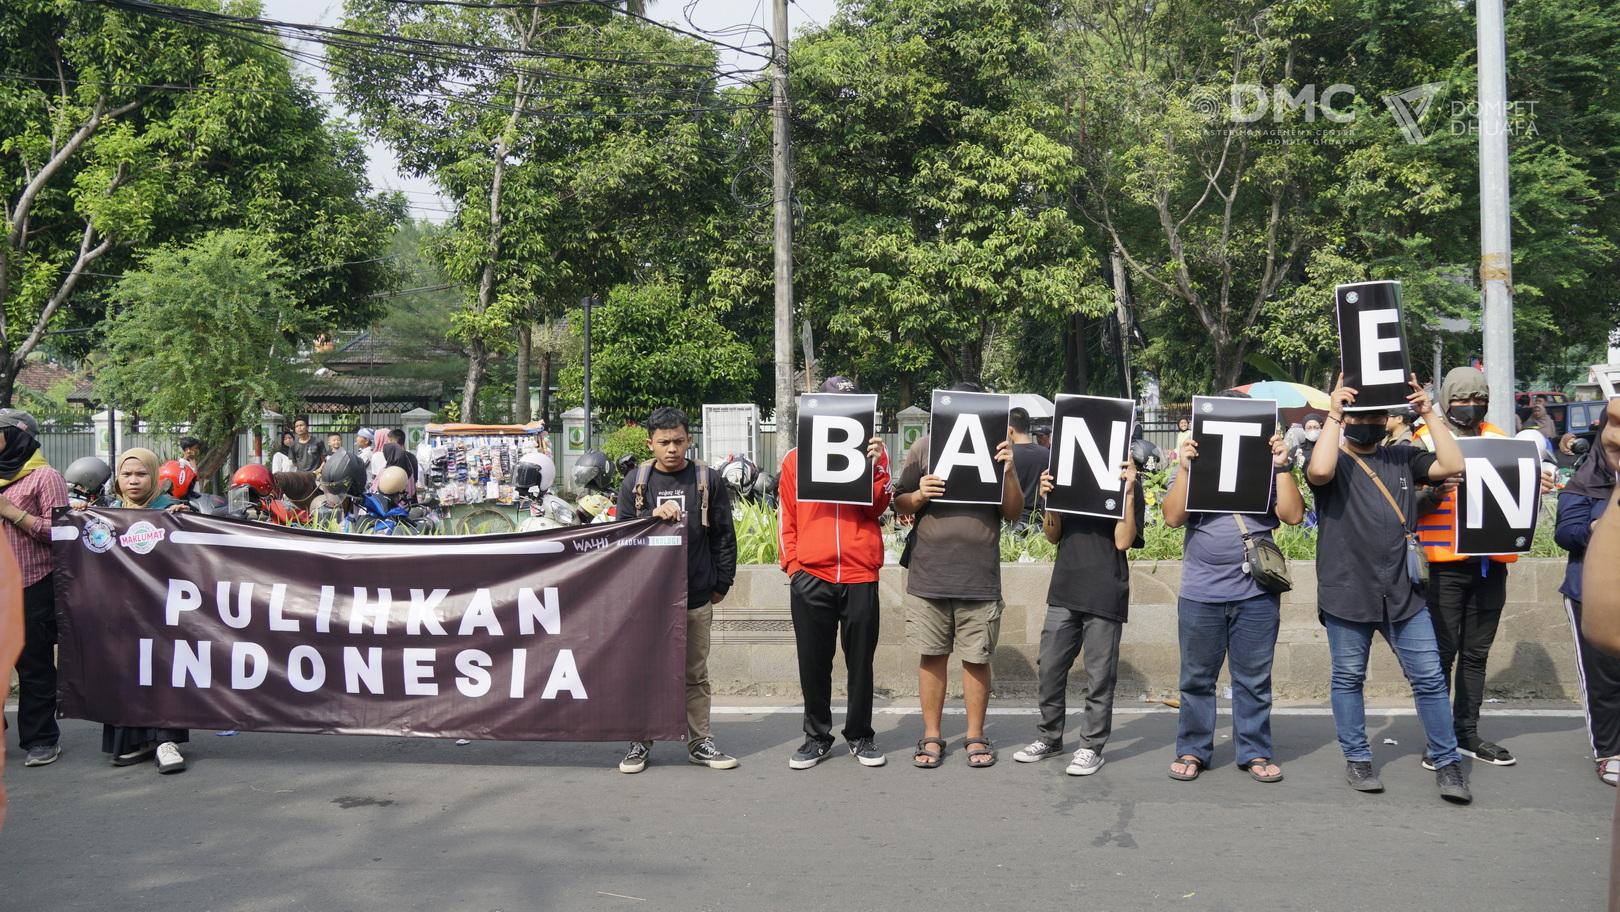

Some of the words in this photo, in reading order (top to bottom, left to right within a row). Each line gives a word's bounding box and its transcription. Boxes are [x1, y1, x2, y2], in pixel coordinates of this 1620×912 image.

[1358, 308, 1405, 386] E
[811, 415, 866, 484] B
[932, 413, 998, 484] A
[1056, 416, 1127, 492] N
[1202, 420, 1262, 493] T
[1465, 457, 1536, 529] N
[121, 530, 164, 545] MAKLUMAT
[572, 537, 609, 552] WALHI
[165, 578, 561, 636] PULIHKAN
[139, 638, 588, 700] INDONESIA
